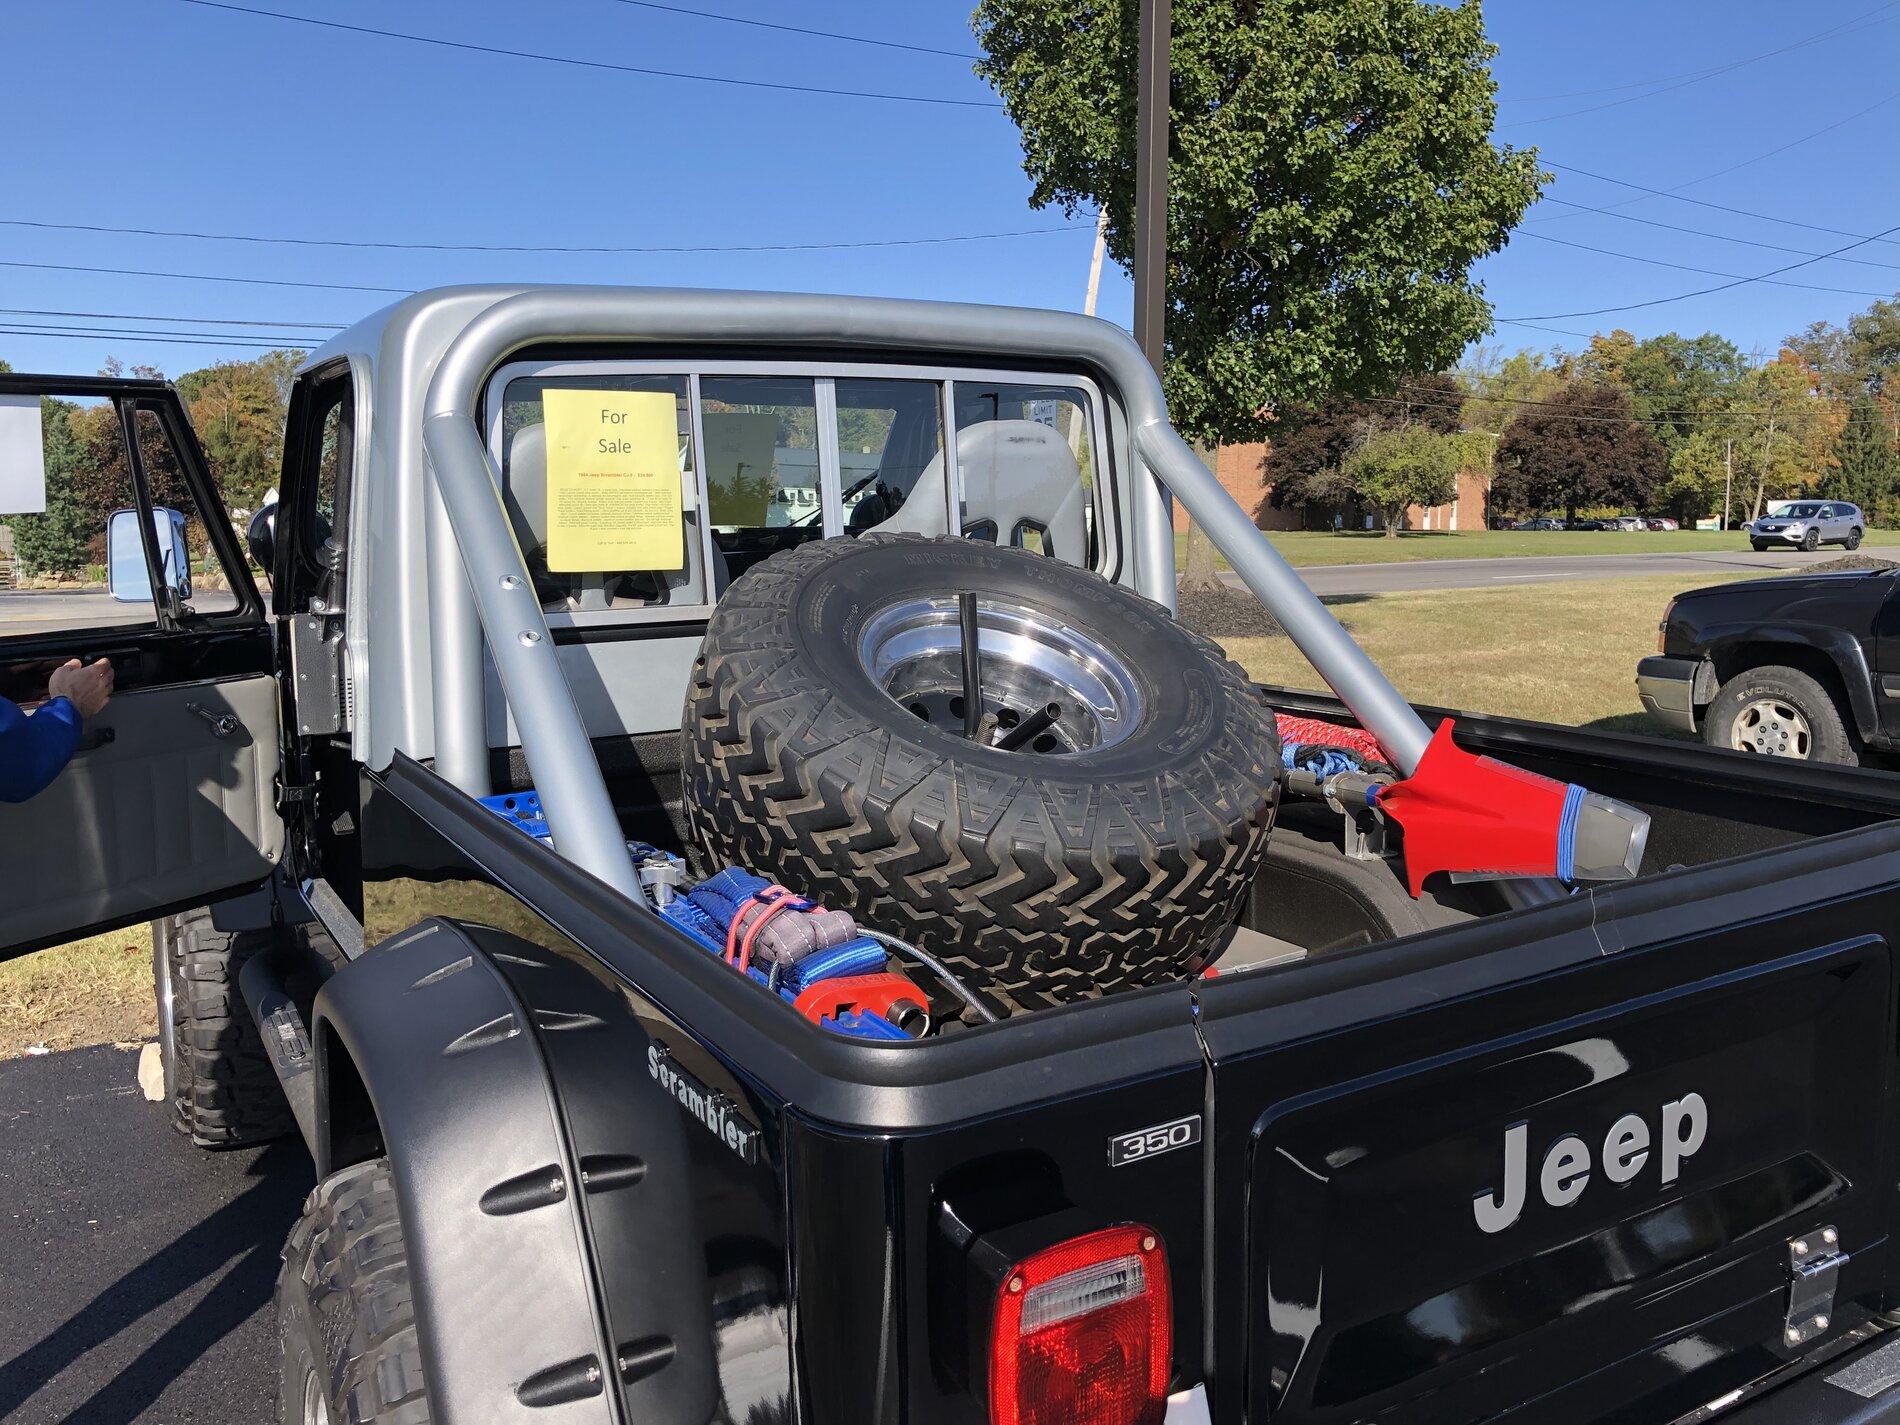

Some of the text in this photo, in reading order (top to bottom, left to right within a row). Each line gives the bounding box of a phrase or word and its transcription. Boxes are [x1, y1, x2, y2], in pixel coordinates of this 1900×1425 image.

[601, 409, 628, 425] For
[1034, 404, 1053, 416] LIMIT
[598, 438, 632, 454] Sale
[903, 552, 1003, 569] MICKEY
[1736, 685, 1816, 720] EVOLUTION
[647, 1044, 750, 1160] Scrambler
[1122, 1123, 1191, 1160] 350
[1472, 1091, 1708, 1234] Jeep
